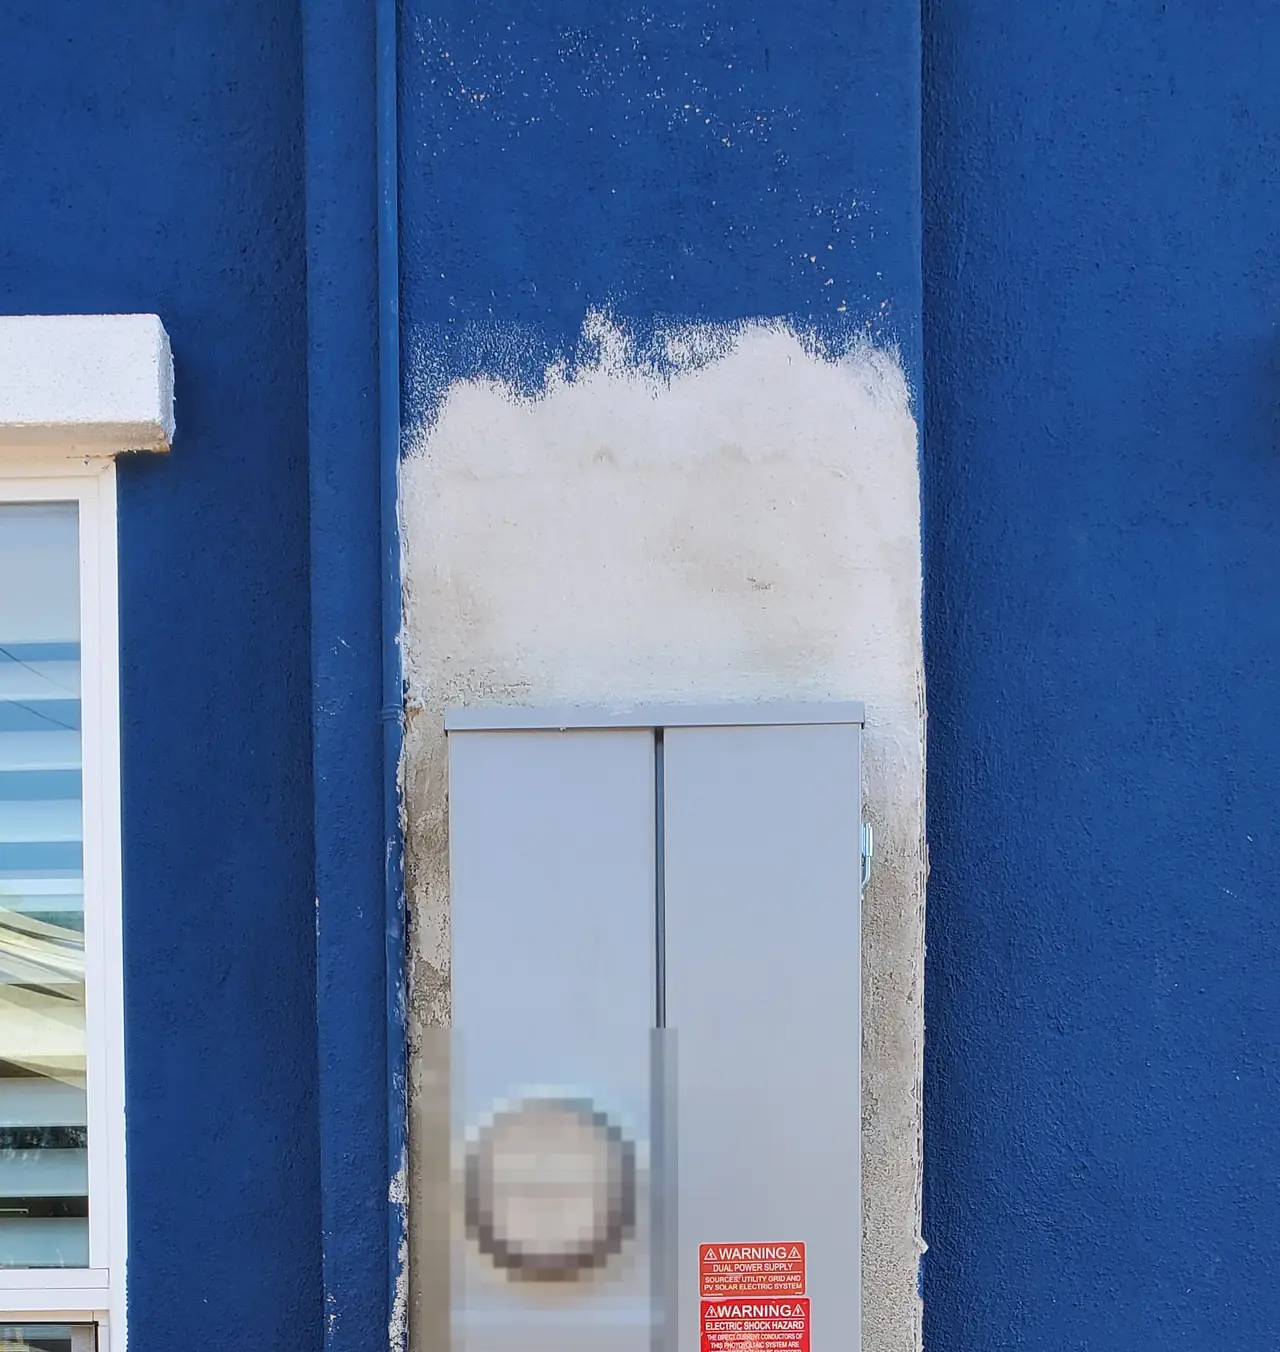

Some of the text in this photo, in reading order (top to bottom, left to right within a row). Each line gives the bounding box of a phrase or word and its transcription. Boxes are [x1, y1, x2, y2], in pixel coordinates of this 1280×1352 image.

[719, 1247, 786, 1260] WARNING
[764, 1263, 793, 1271] SUPPLY
[718, 1305, 791, 1317] WARNING
[706, 1321, 804, 1330] ELECTRIC SHOCK HAZARD
